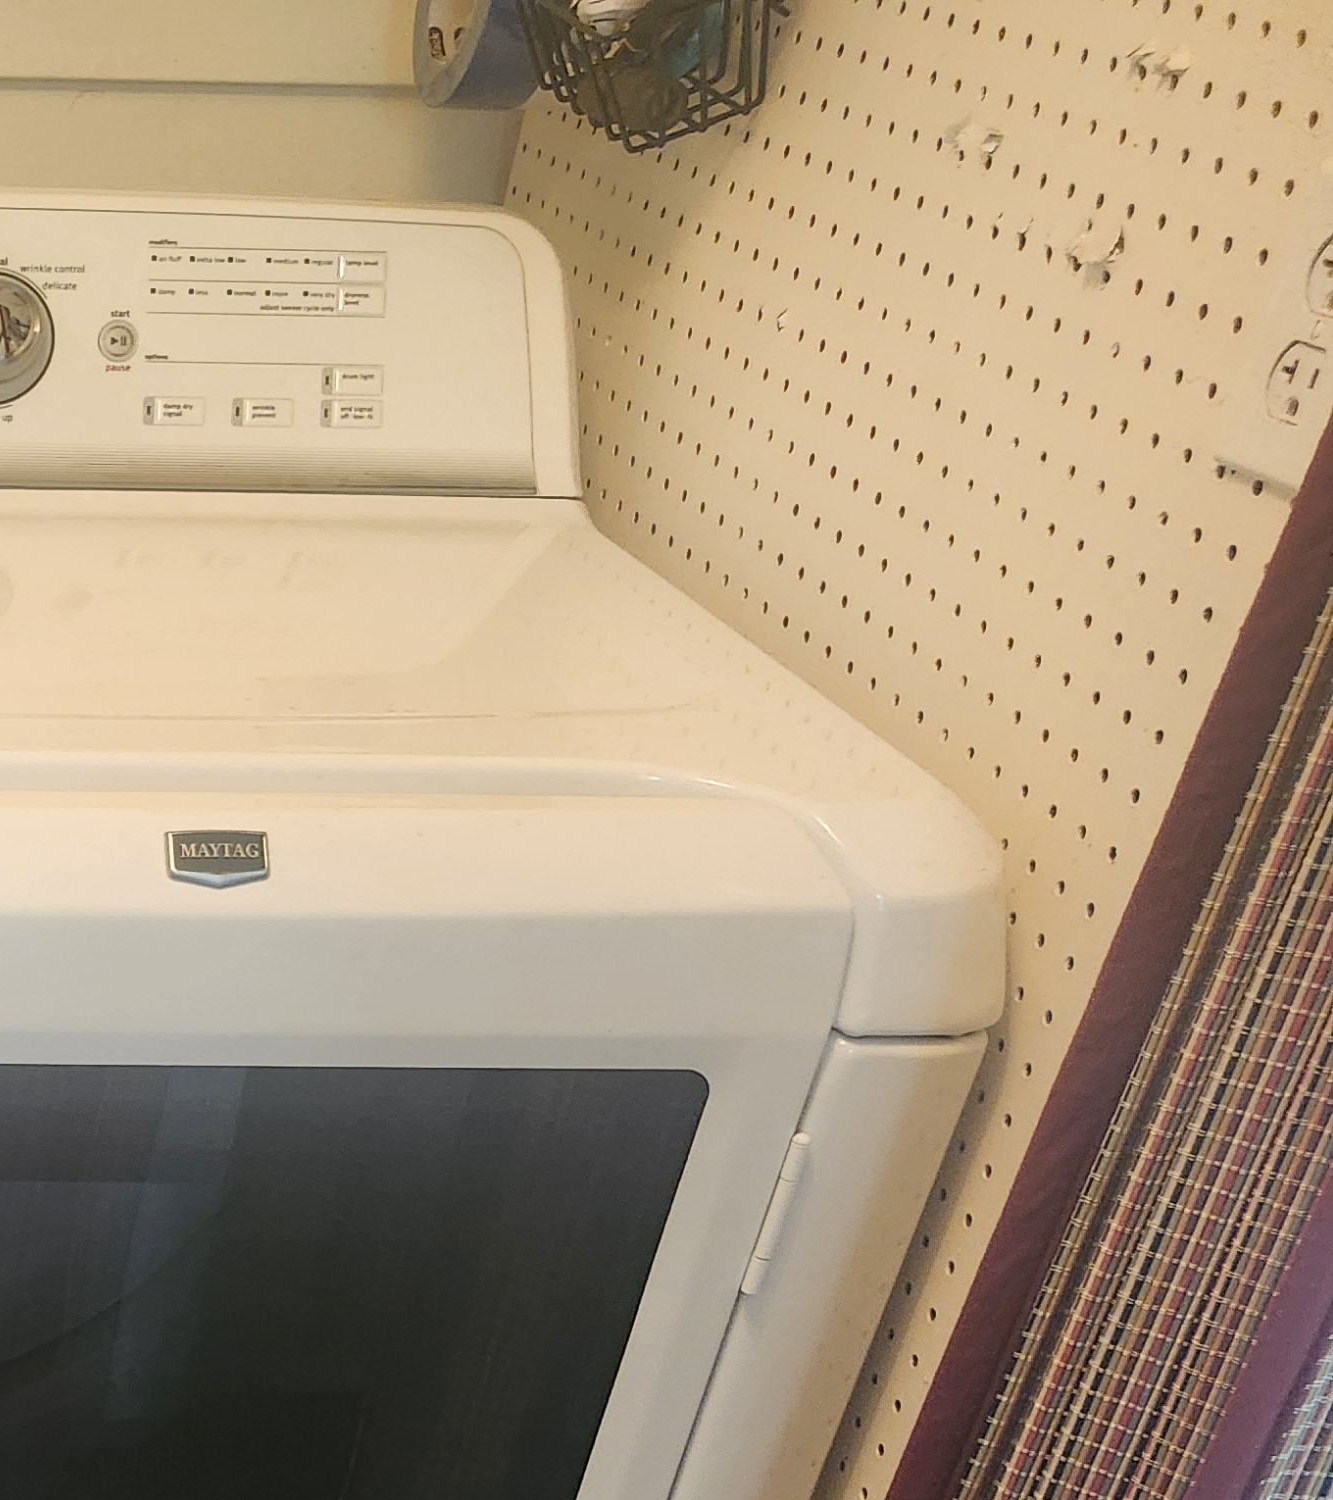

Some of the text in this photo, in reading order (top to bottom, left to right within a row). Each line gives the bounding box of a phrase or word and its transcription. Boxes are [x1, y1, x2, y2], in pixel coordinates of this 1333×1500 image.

[54, 265, 85, 273] control
[42, 282, 77, 291] delicate
[110, 310, 130, 318] start
[105, 364, 131, 373] pause
[2, 414, 13, 423] up
[179, 842, 261, 859] MAYTAG
